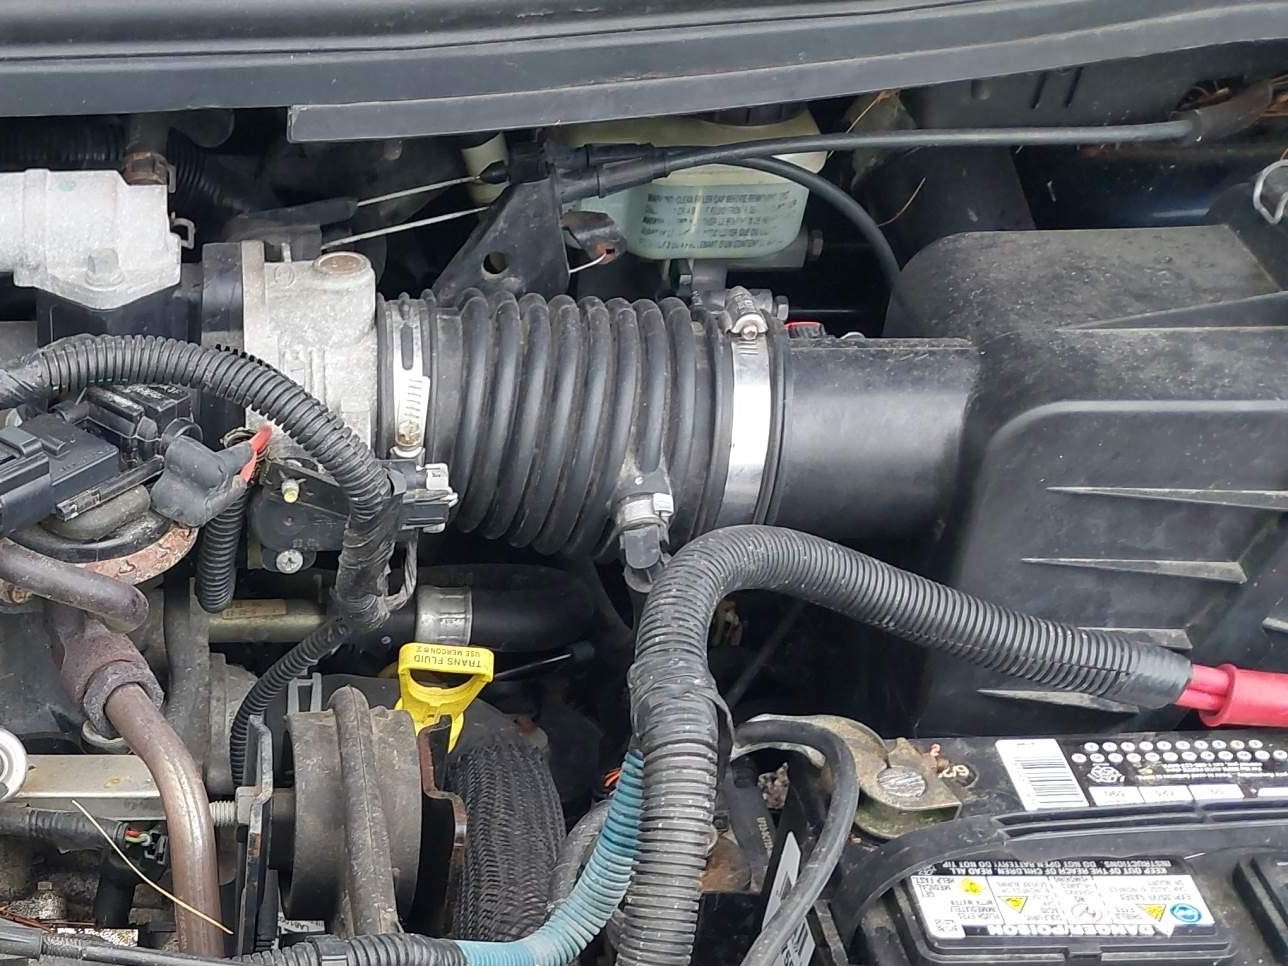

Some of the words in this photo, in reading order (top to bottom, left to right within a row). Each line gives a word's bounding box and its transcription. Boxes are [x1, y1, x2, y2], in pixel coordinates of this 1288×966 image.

[414, 655, 444, 664] FLUID
[447, 657, 482, 668] TRANS
[942, 860, 958, 868] TIP
[959, 860, 976, 868] NOT
[979, 860, 992, 868] DO
[1064, 860, 1081, 868] NOT
[1082, 860, 1096, 868] DO
[987, 924, 1154, 936] DANGER/POISON
